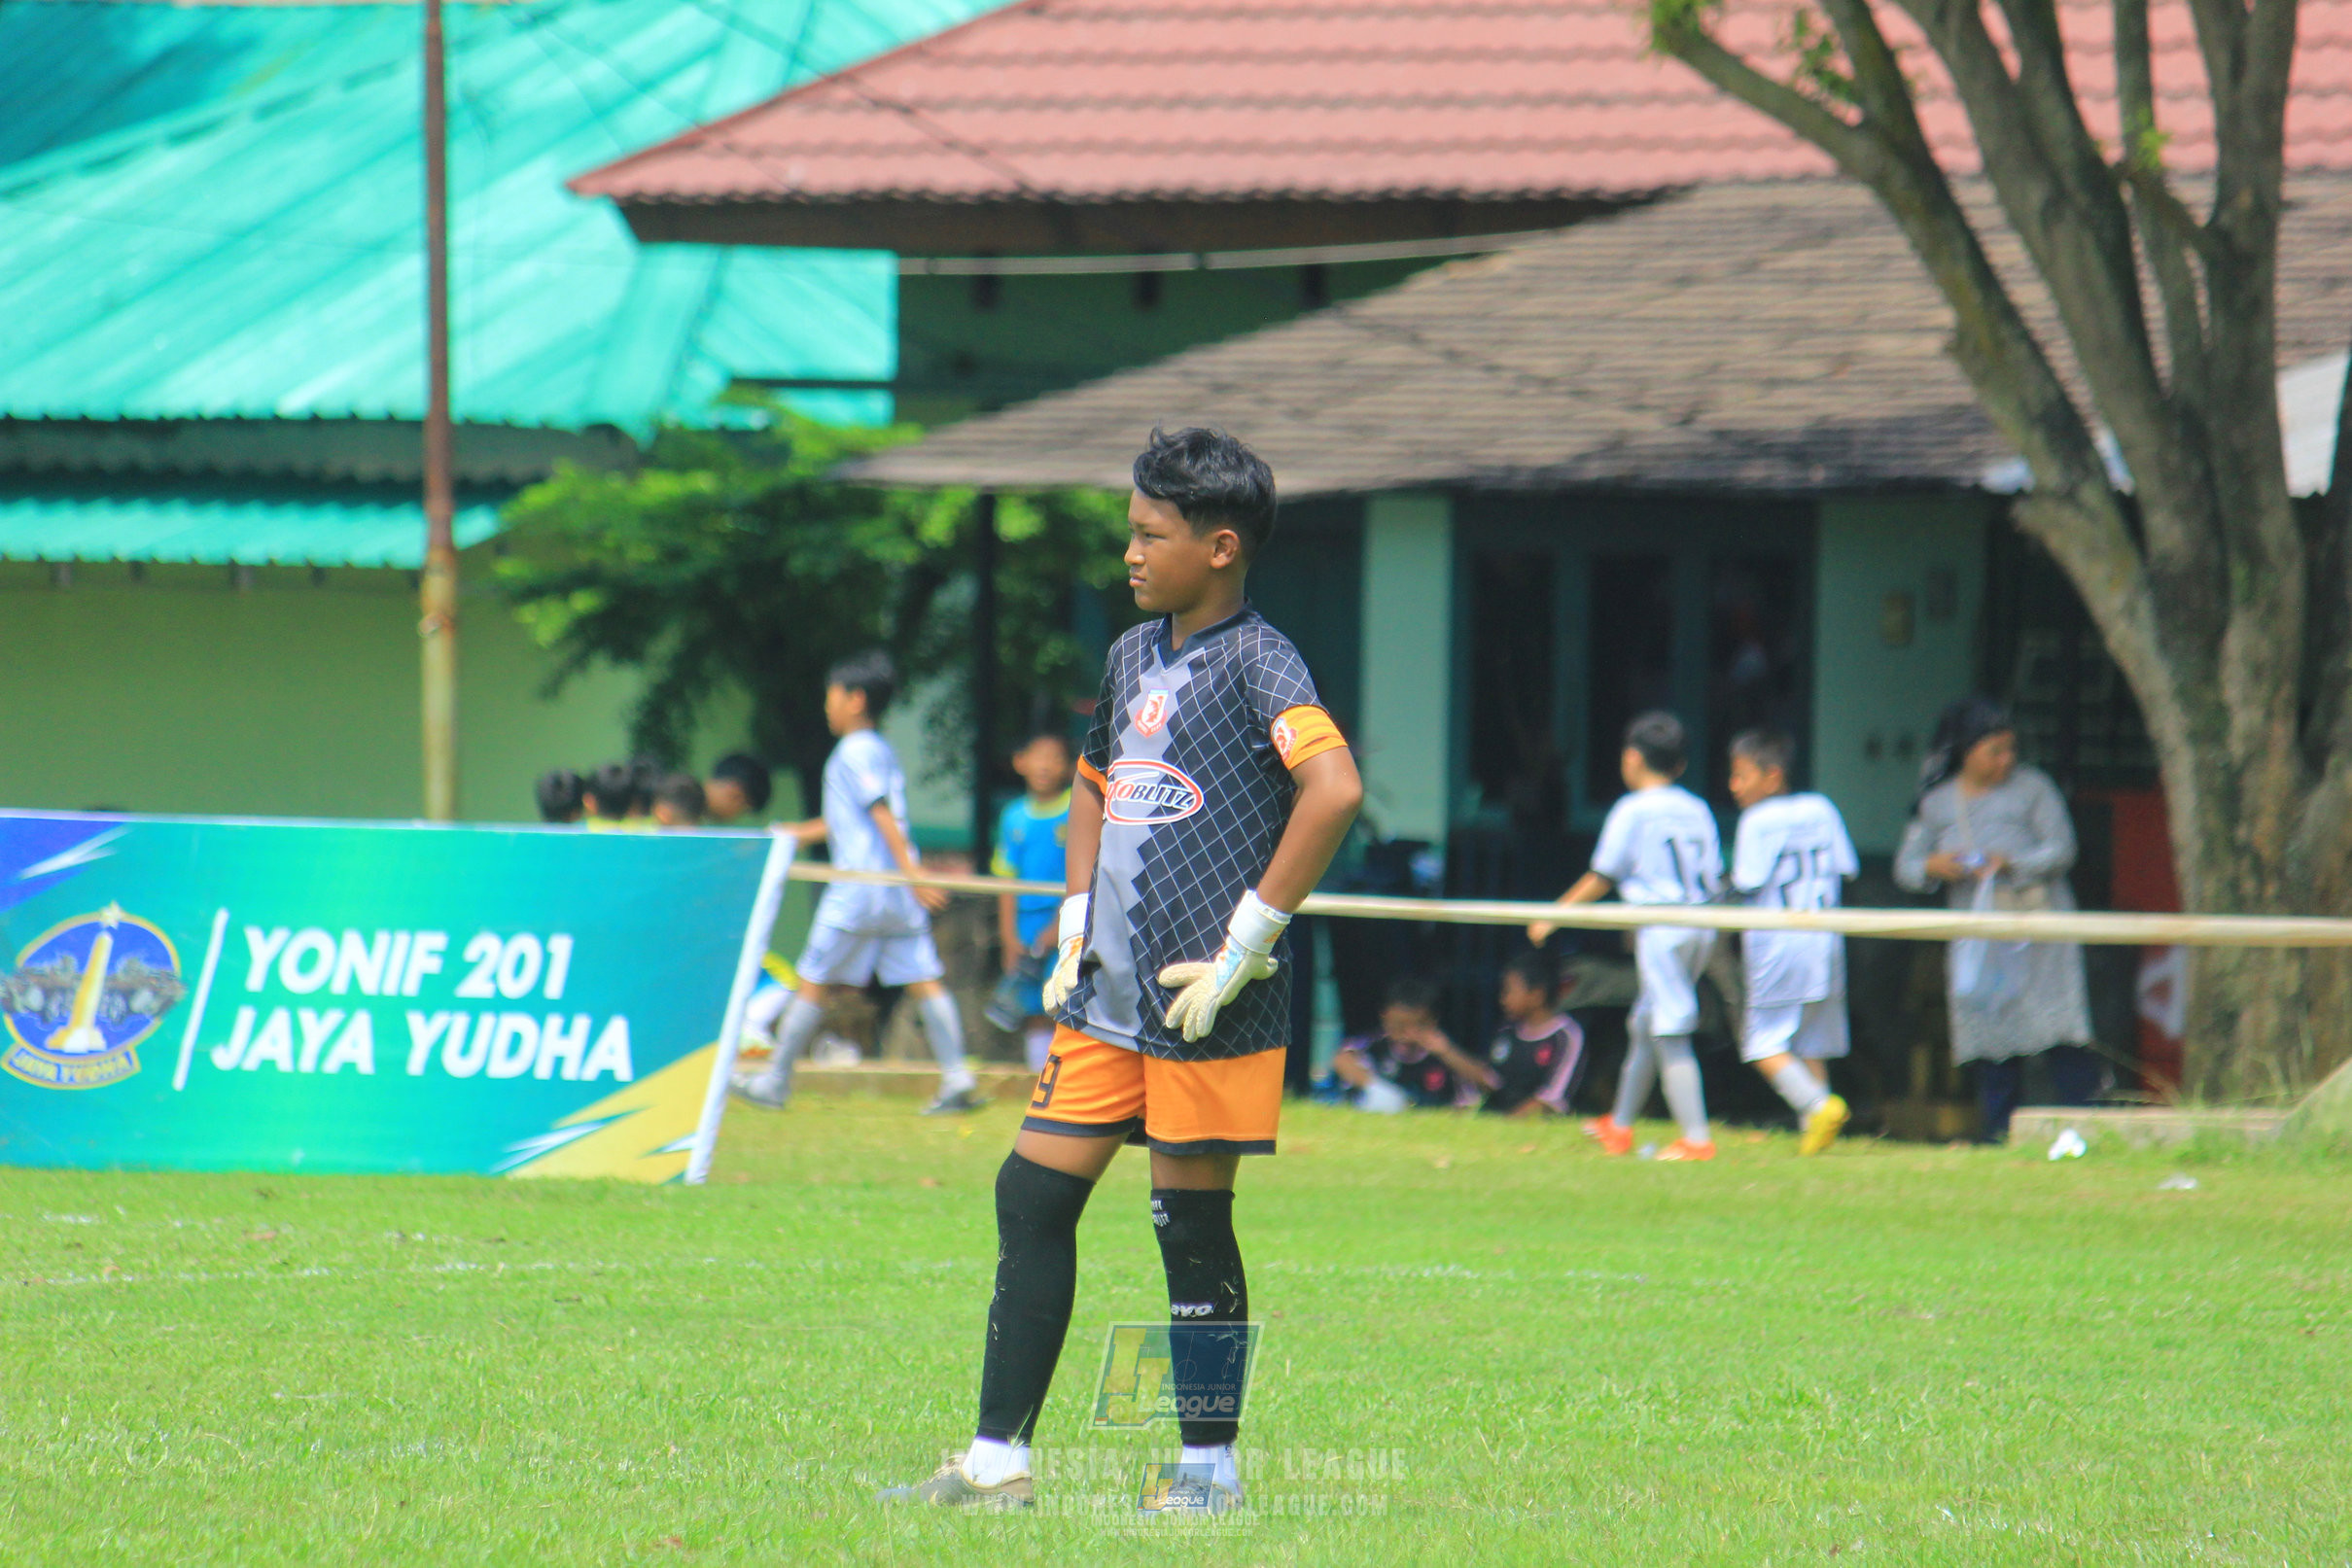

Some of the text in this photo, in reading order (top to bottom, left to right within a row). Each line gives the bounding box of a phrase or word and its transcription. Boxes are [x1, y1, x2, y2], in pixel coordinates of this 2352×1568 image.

[243, 925, 575, 1002] YONIF 201
[210, 1006, 635, 1083] JAYA YUDHA
